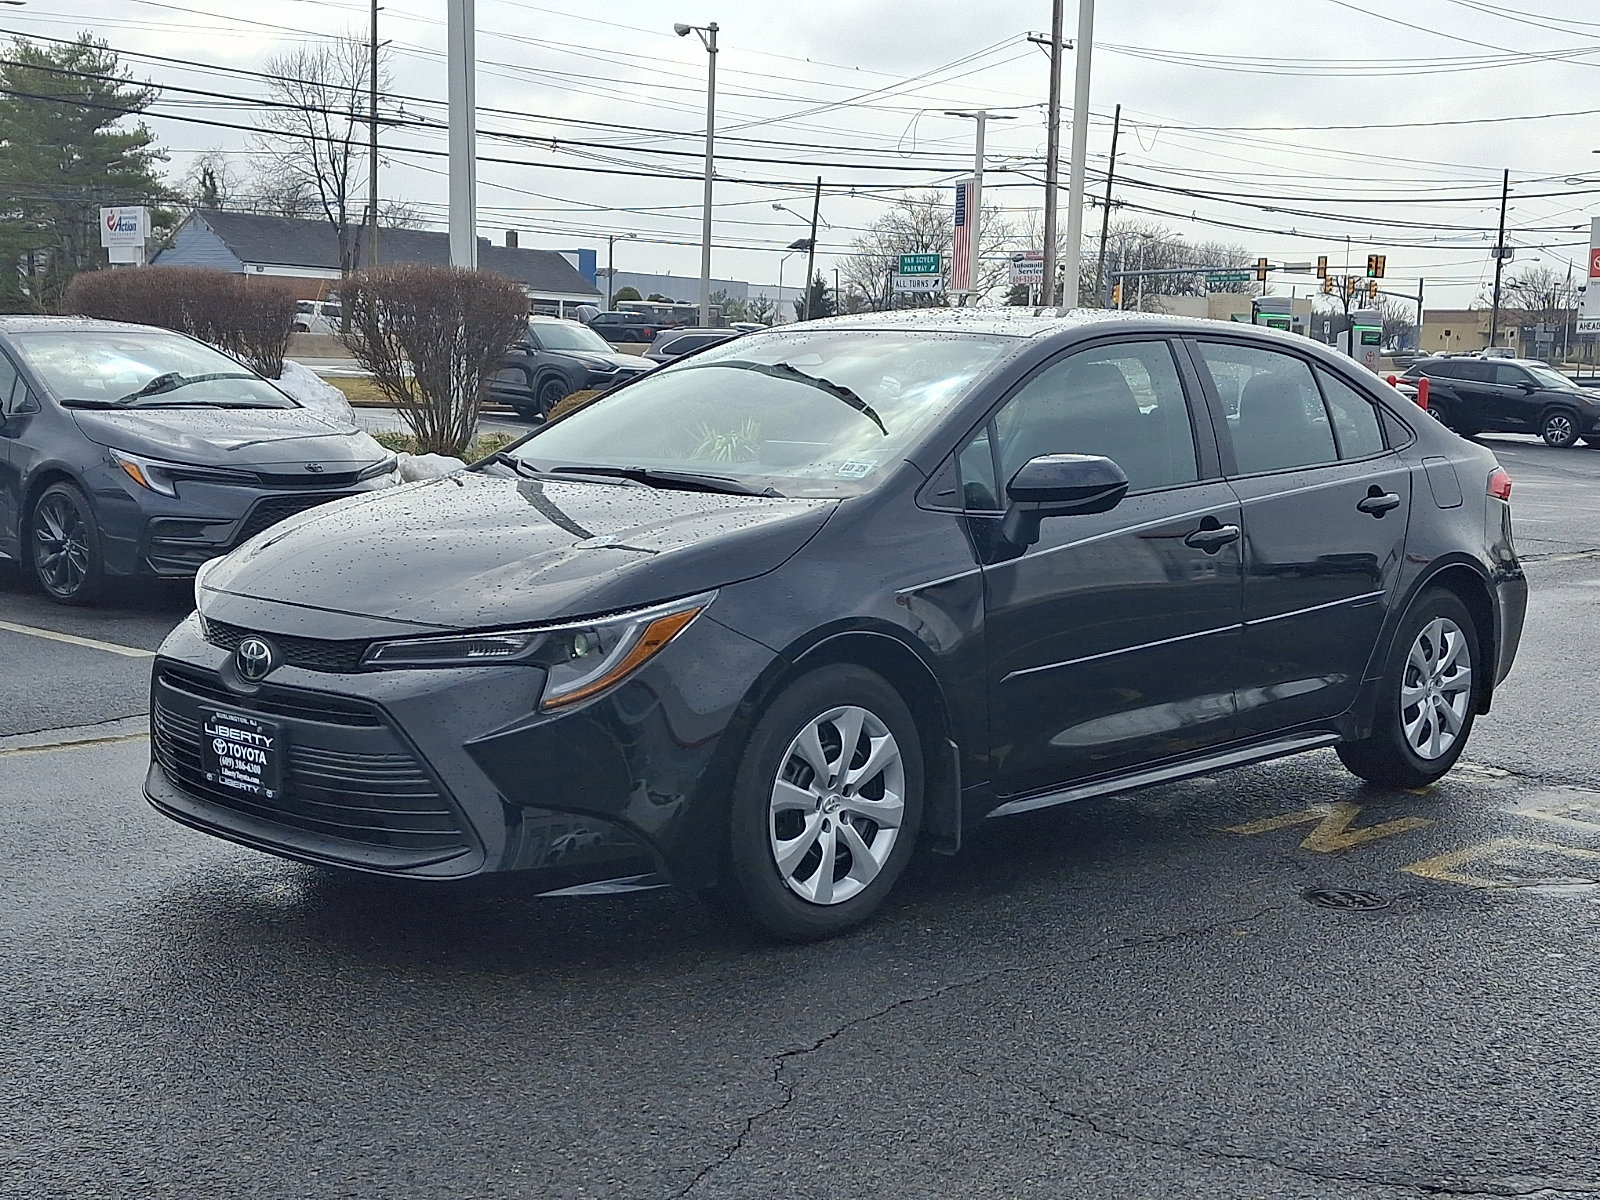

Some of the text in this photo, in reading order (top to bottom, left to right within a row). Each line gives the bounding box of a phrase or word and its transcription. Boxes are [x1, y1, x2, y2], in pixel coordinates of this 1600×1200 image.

[114, 216, 137, 231] Action
[896, 279, 929, 288] ALL TURNS
[204, 722, 274, 748] LIBERTY
[219, 755, 235, 770] (609)
[227, 742, 268, 766] TOYOTA
[218, 775, 261, 794] LIBERTY
